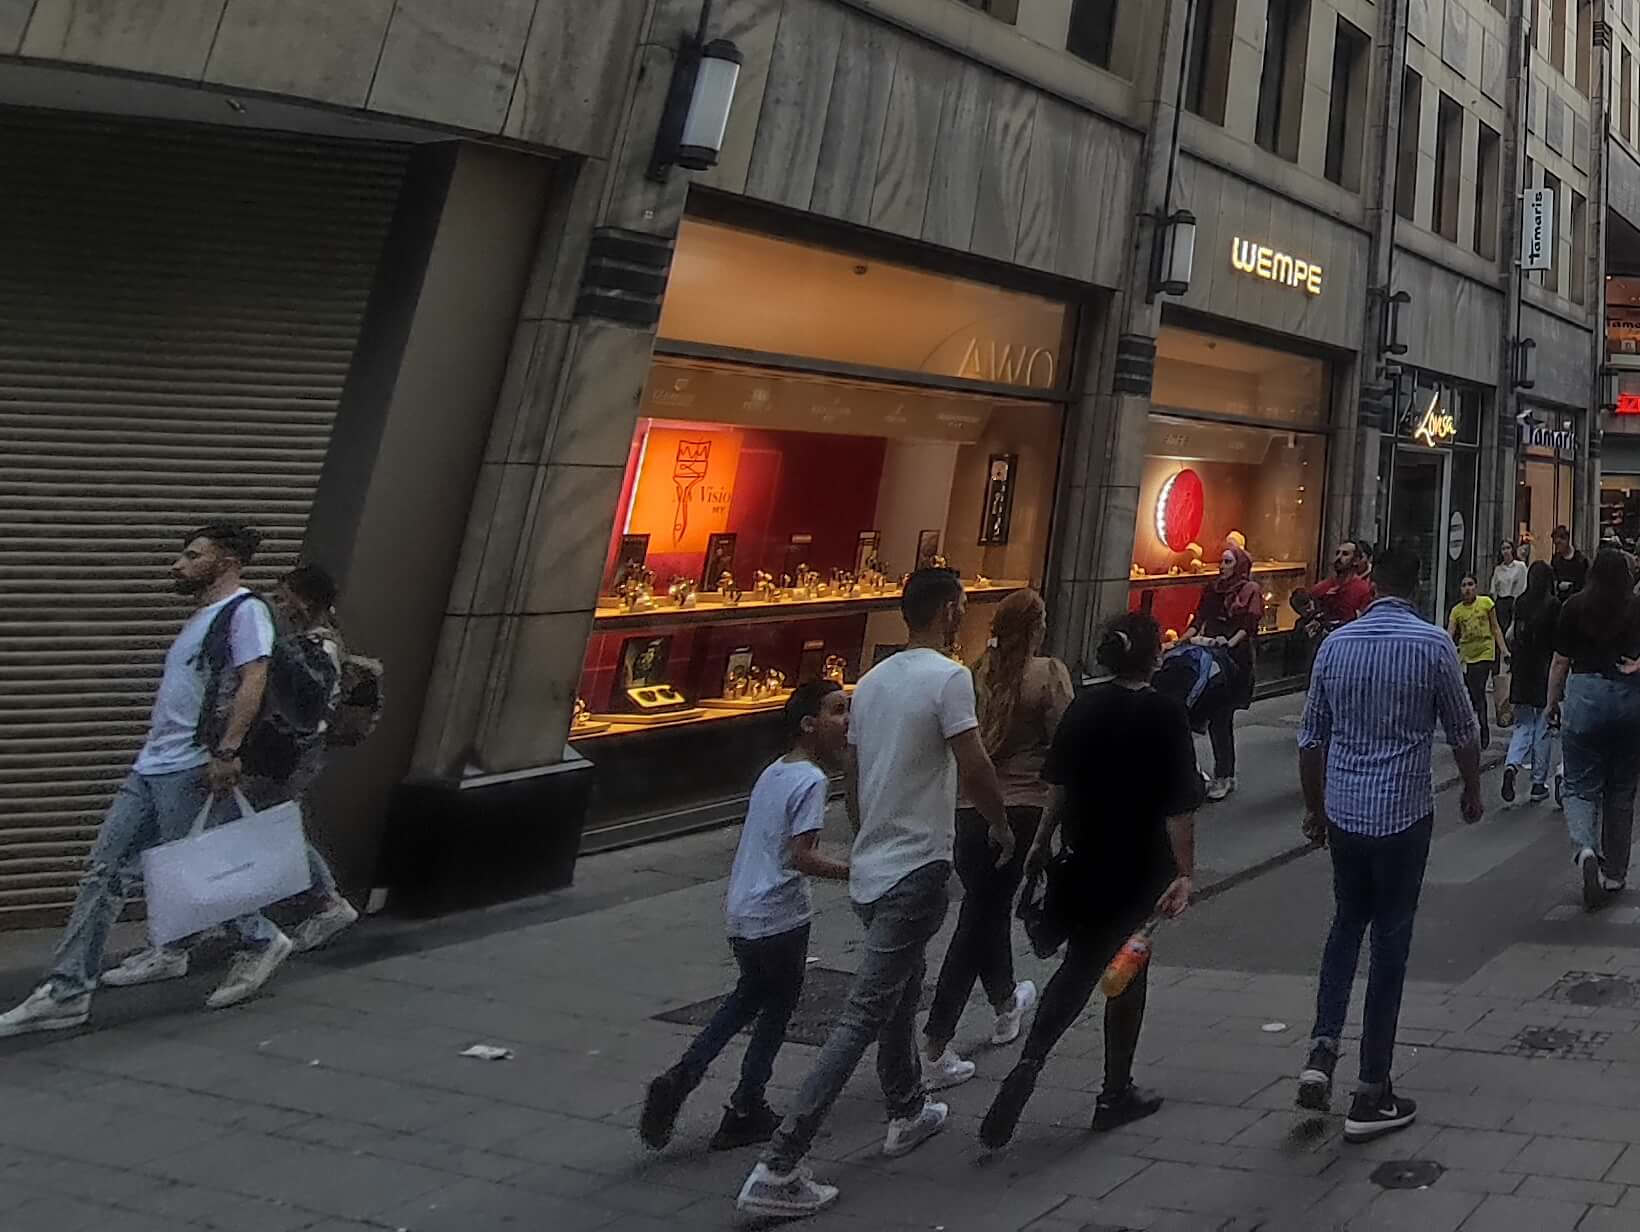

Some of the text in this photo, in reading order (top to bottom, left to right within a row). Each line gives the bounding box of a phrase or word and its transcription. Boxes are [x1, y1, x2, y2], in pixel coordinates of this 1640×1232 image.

[1528, 191, 1543, 265] Tamaris
[1231, 236, 1322, 295] WEMPE
[1415, 392, 1457, 448] Lovisa
